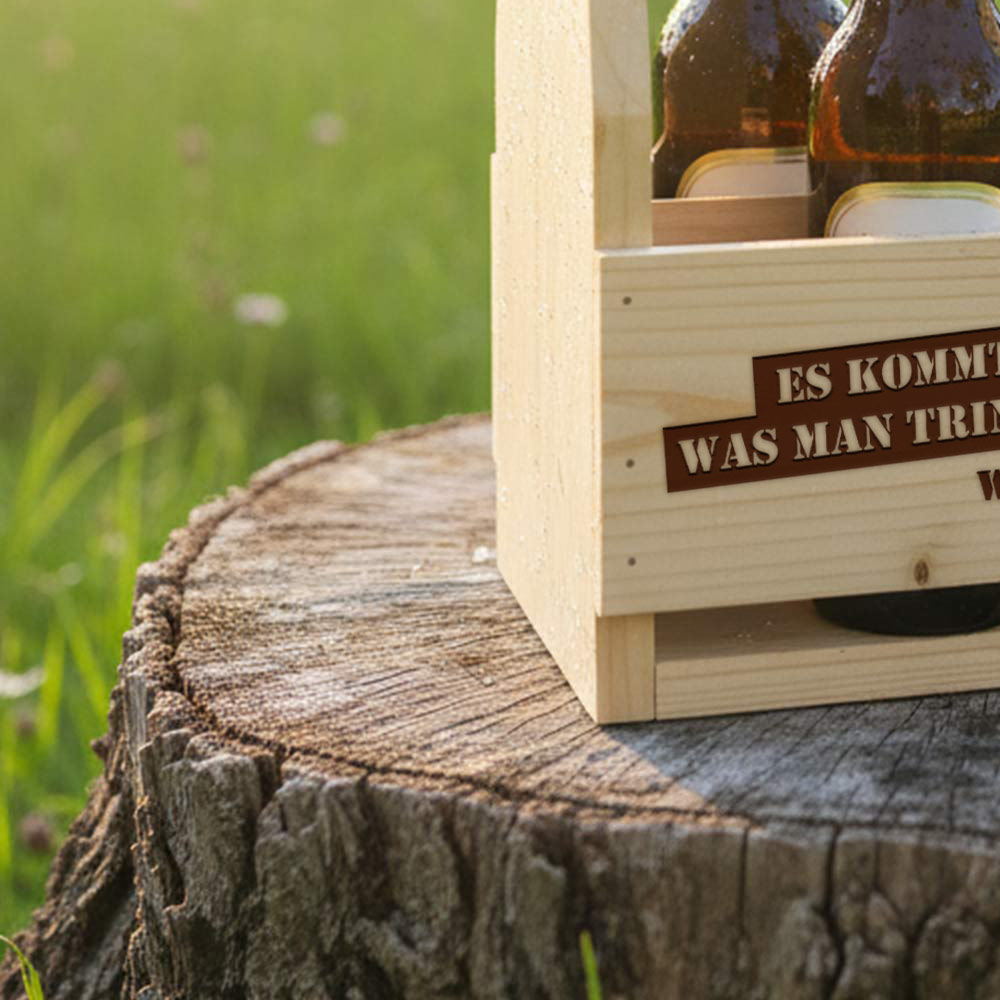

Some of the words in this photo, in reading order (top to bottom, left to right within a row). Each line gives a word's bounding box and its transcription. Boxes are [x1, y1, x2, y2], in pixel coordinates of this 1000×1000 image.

[776, 362, 832, 404] ES
[677, 428, 779, 475] WAS
[792, 413, 893, 461] MAN
